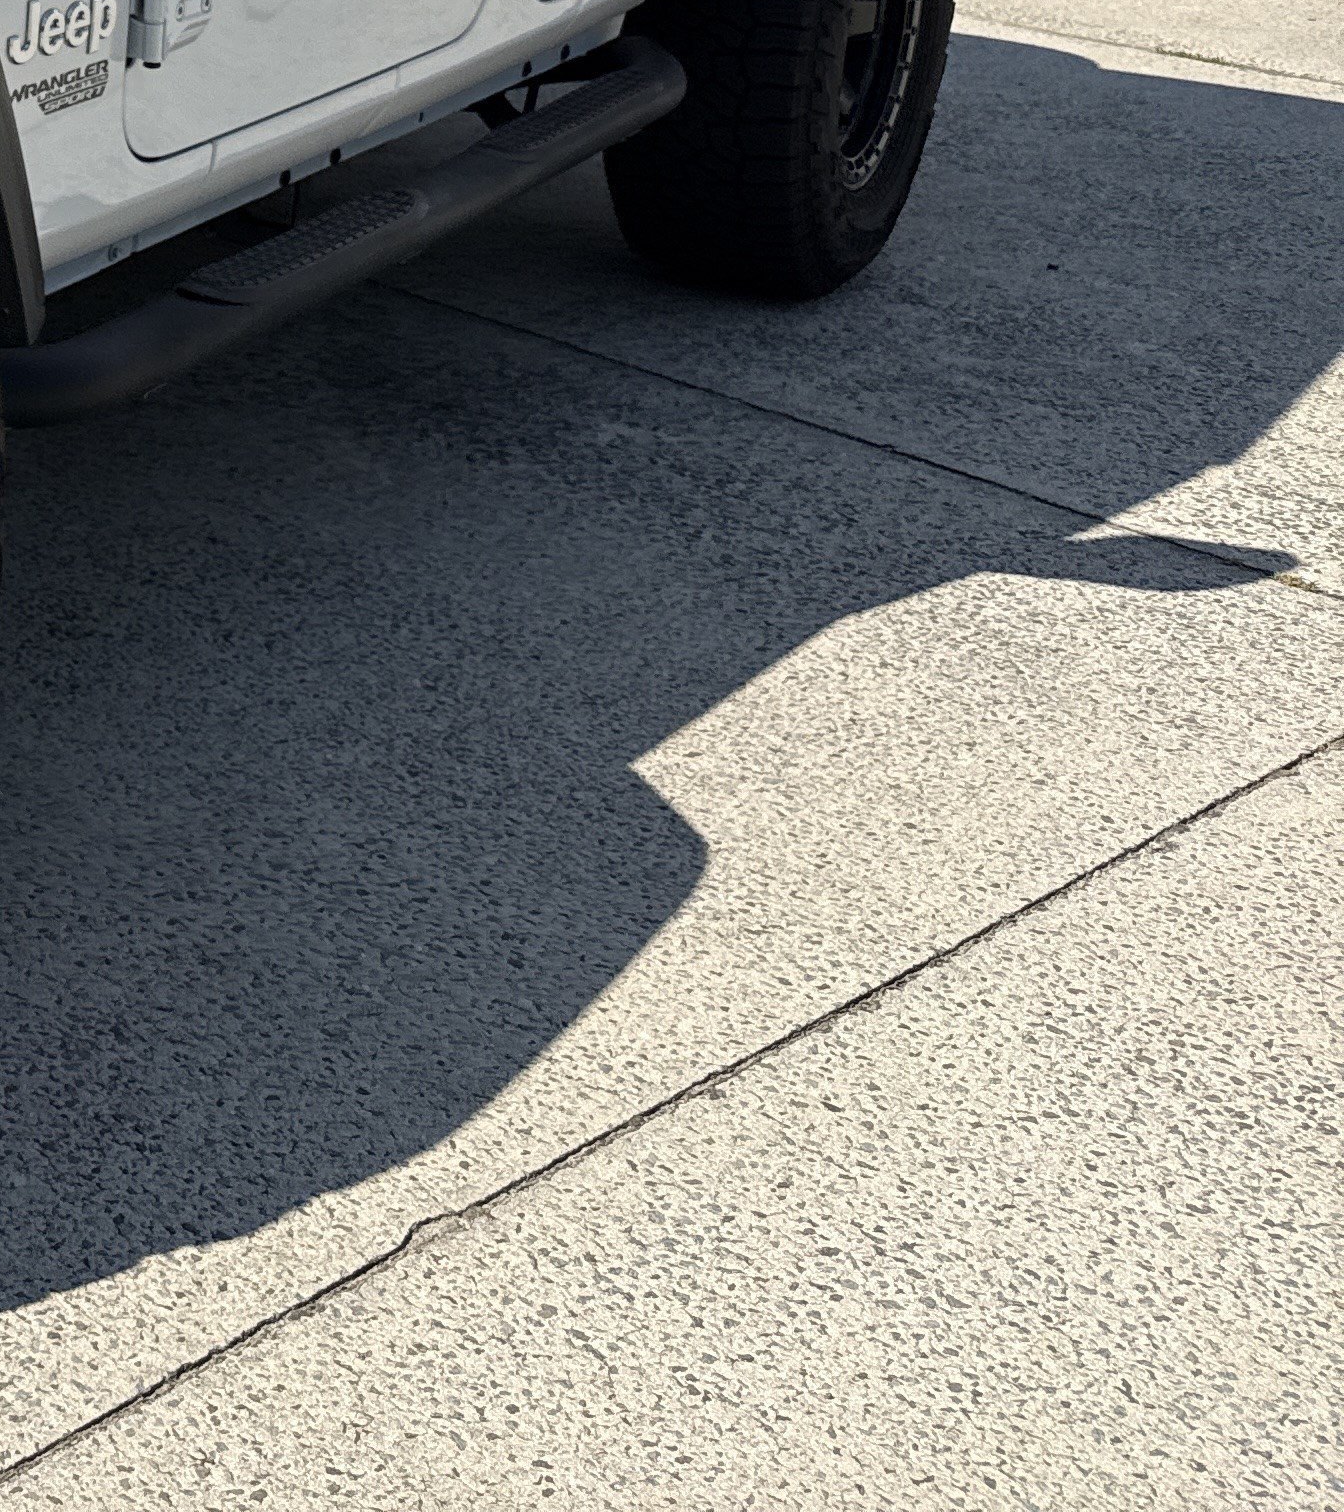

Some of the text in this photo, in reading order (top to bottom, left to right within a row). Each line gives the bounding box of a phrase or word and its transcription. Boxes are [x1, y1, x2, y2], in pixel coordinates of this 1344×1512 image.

[11, 59, 109, 103] WRANGLER
[37, 73, 109, 103] UNLIMITED
[41, 84, 108, 112] SPORT
